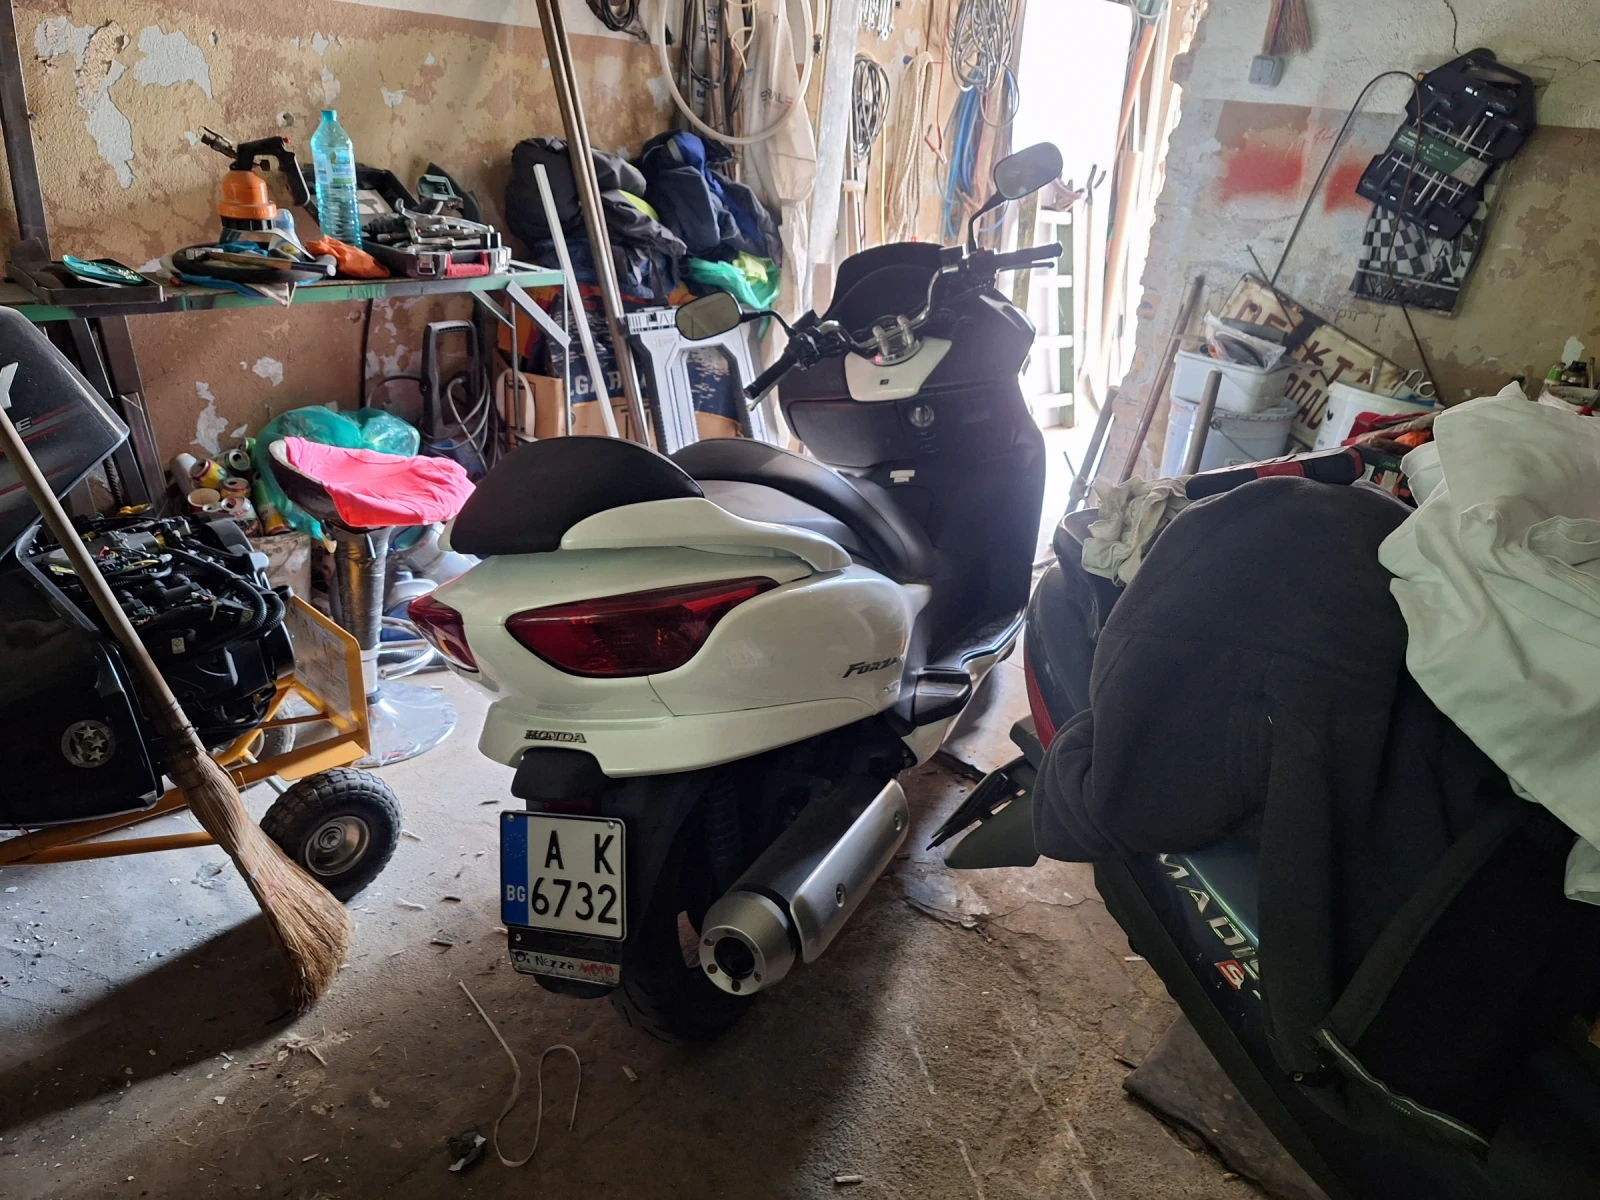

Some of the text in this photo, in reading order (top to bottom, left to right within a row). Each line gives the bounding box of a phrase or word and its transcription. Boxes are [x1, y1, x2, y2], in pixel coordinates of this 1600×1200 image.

[524, 730, 587, 743] HONDA
[544, 830, 616, 875] A K
[506, 884, 526, 902] BG
[531, 877, 618, 925] 6732
